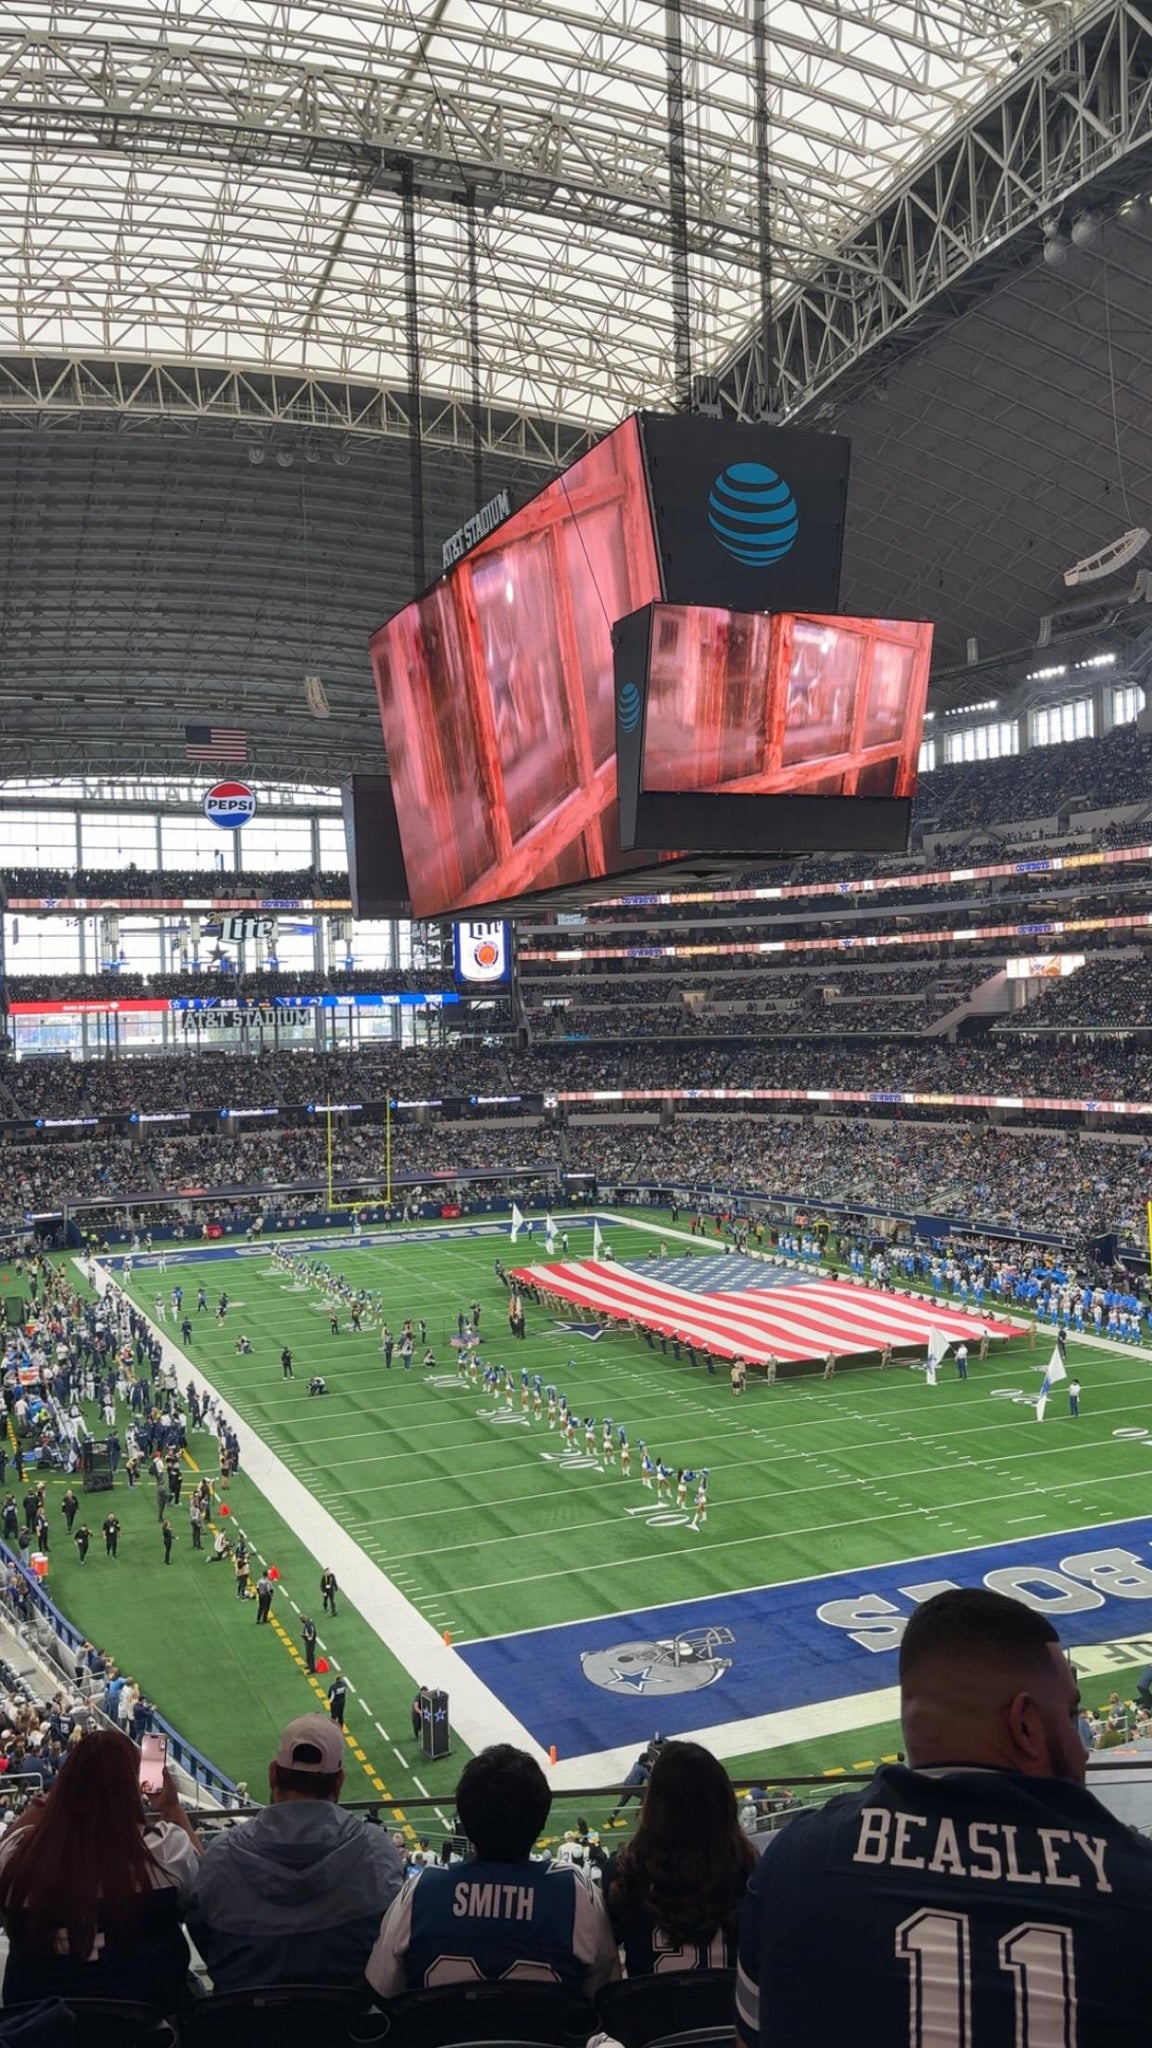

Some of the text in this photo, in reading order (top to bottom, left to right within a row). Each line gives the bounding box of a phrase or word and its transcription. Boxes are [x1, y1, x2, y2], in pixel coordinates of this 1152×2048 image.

[443, 488, 511, 569] AT&T STADIUM
[208, 800, 253, 811] PEPSI
[218, 915, 273, 945] Lite
[184, 1009, 310, 1029] AT&T STADIUM
[622, 1501, 691, 1528] 10
[851, 1807, 1113, 1893] BEASLEY
[453, 1881, 534, 1921] SMITH
[895, 1907, 1078, 2048] 11
